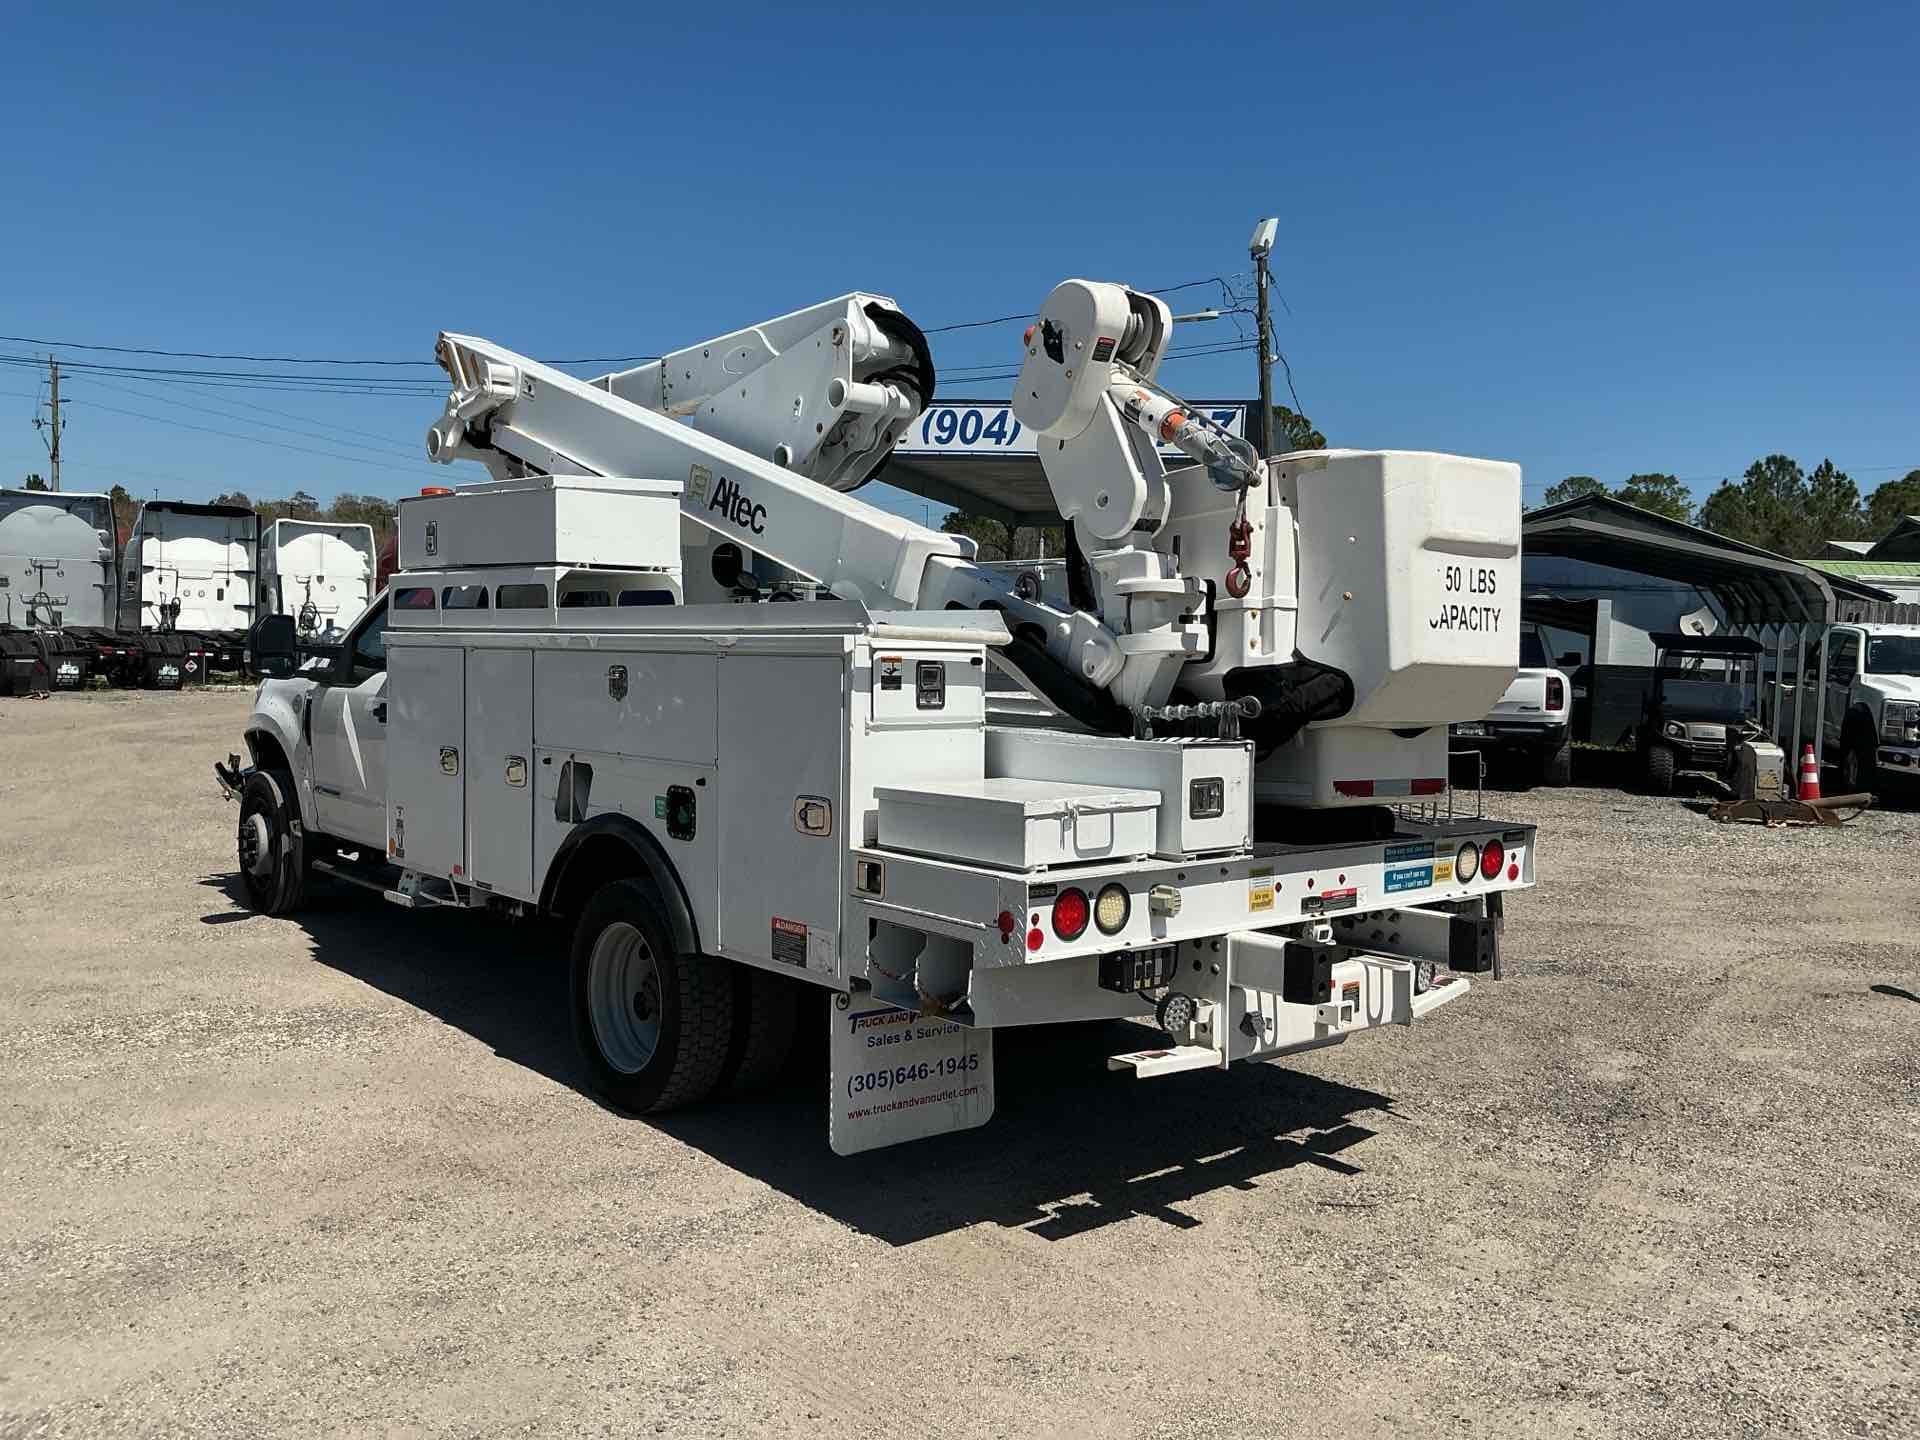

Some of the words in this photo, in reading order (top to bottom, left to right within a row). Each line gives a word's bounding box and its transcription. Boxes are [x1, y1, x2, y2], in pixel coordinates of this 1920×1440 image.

[922, 409, 1021, 446] (904)
[708, 476, 767, 534] Altec
[1441, 566, 1462, 592] 50
[1469, 568, 1496, 594] LBS
[848, 1011, 886, 1034] TRUCK
[867, 1033, 901, 1048] Sales
[904, 1029, 913, 1041] &
[917, 1022, 960, 1040] Service
[847, 1053, 978, 1098] (305)646-1945
[847, 1085, 978, 1120] www.truckandvanoutlet.com
